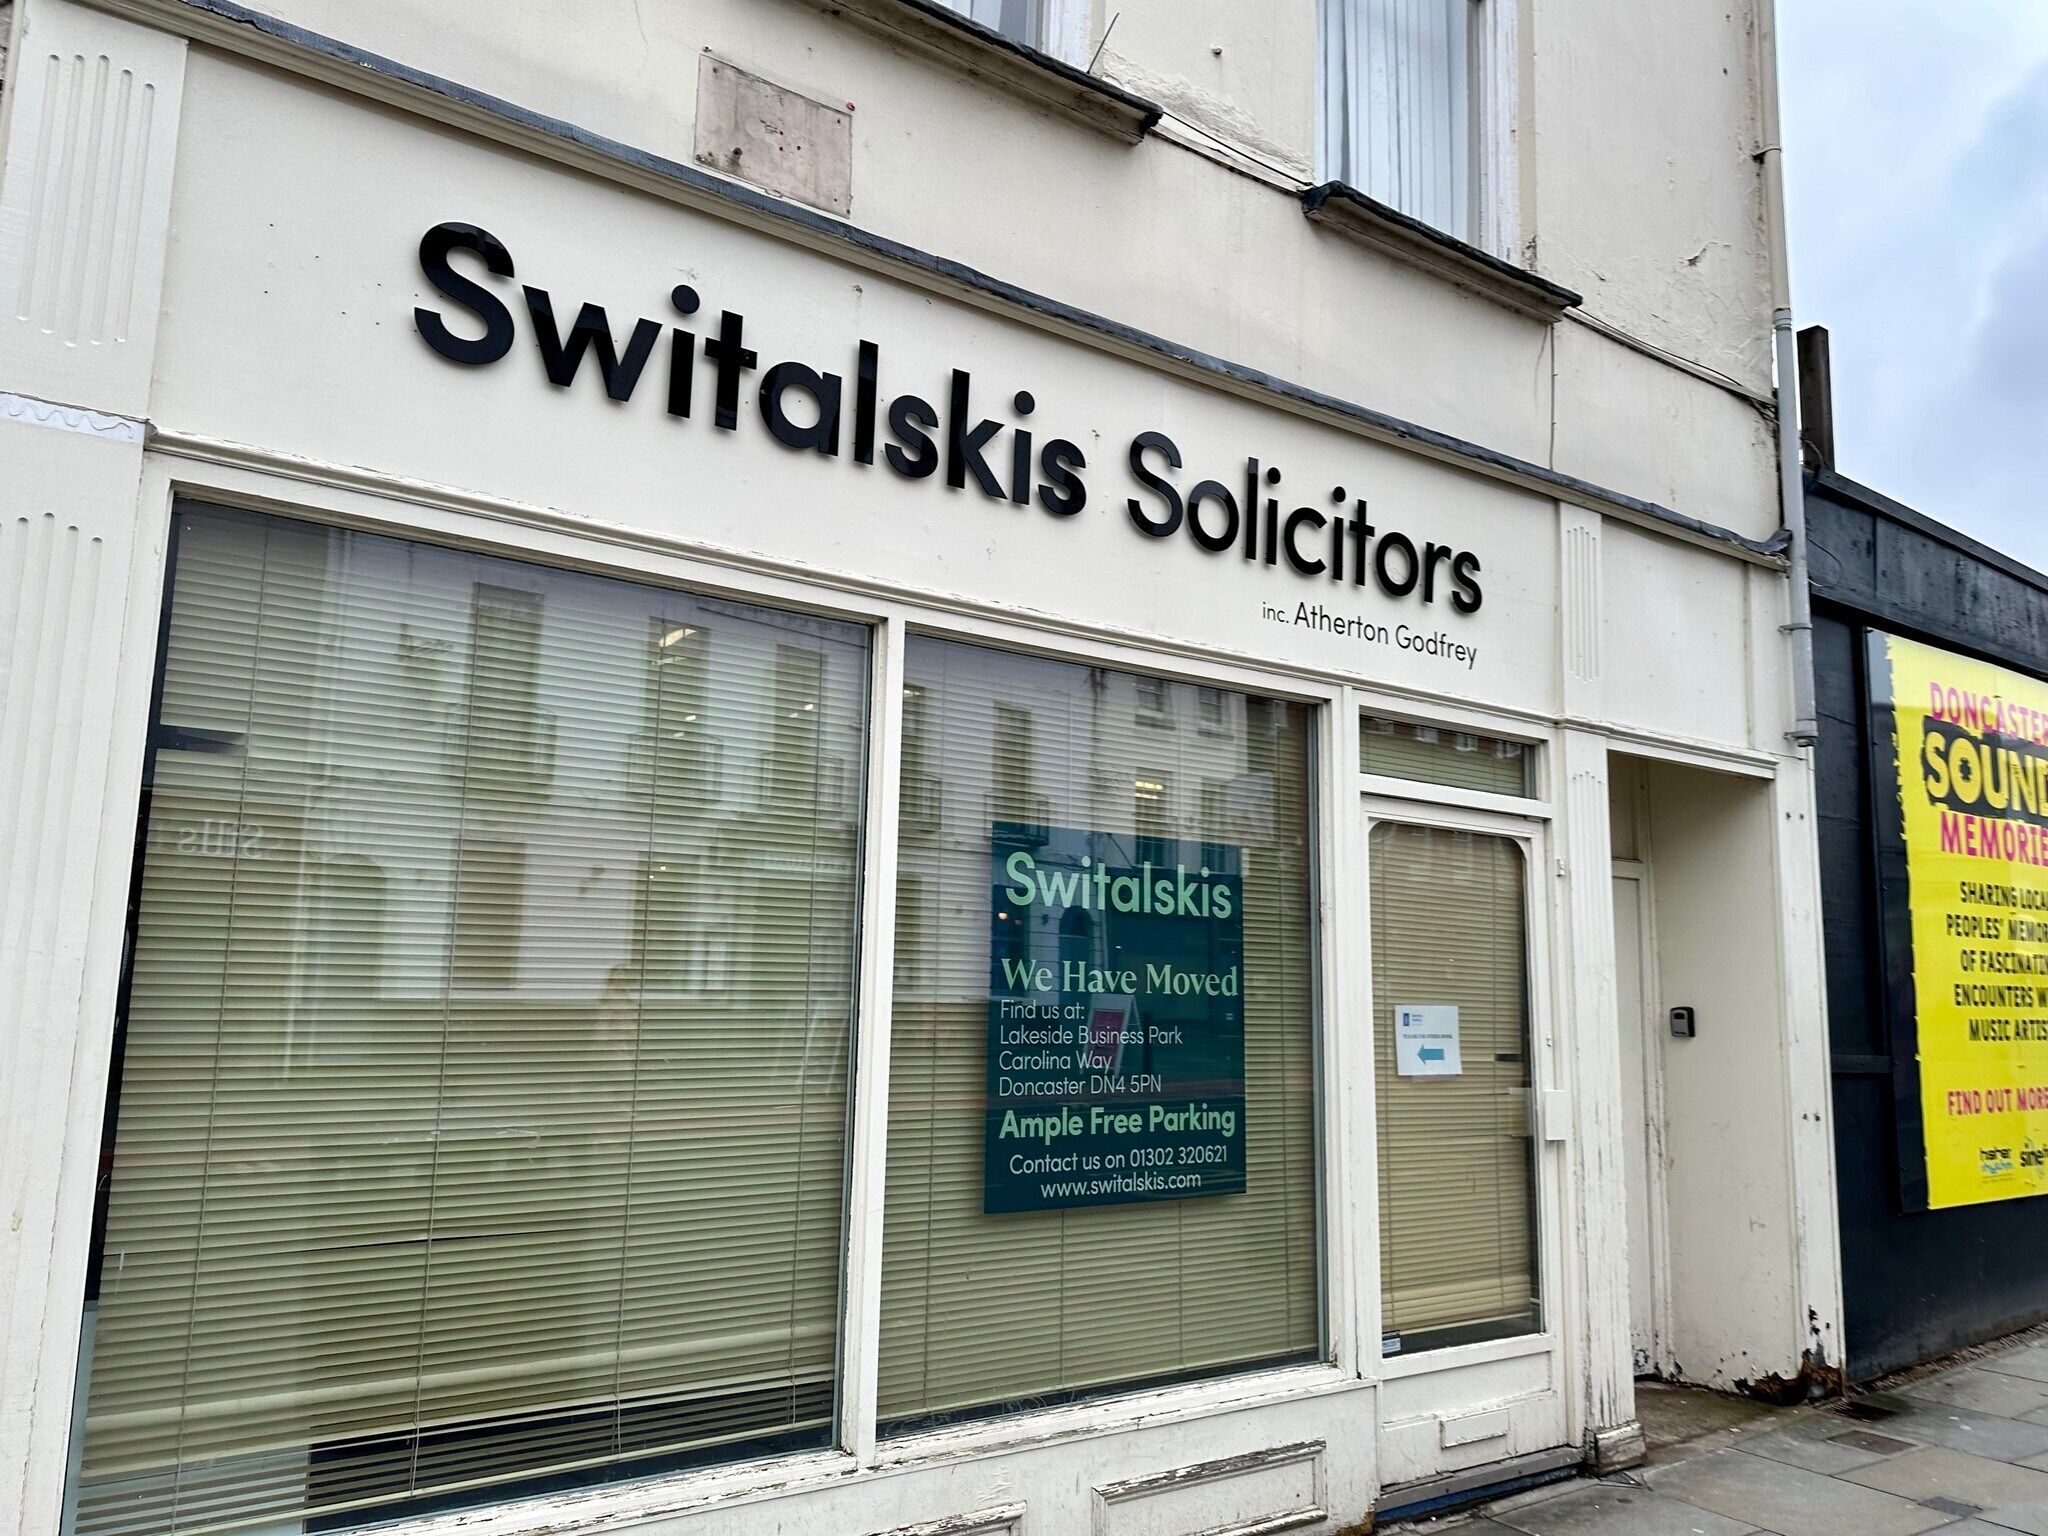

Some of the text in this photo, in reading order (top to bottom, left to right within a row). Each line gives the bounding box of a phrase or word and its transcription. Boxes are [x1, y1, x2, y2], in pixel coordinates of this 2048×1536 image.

[414, 222, 1483, 613] Switalskis Solicitors
[1262, 601, 1478, 670] inc. Atherton Godfrey
[1006, 851, 1233, 919] Switalskis
[1960, 880, 2018, 908] SHARING
[1960, 949, 1977, 972] OF
[1000, 957, 1239, 997] We Have Moved
[1000, 999, 1085, 1020] Find us at:
[1953, 983, 2034, 1008] ENCOUNTERS
[1000, 1024, 1184, 1045] Lakeside Business Park
[1968, 1018, 2011, 1042] MUSIC
[999, 1049, 1113, 1075] Carolina Way
[999, 1074, 1162, 1097] Doncaster DN4 5PN
[1947, 1089, 1982, 1116] FIND
[1985, 1087, 2012, 1114] OUT
[998, 1102, 1236, 1146] Ample Free Parking
[1009, 1144, 1228, 1175] Contact us on 01302 320621
[1040, 1170, 1201, 1198] www.switalskis.com
